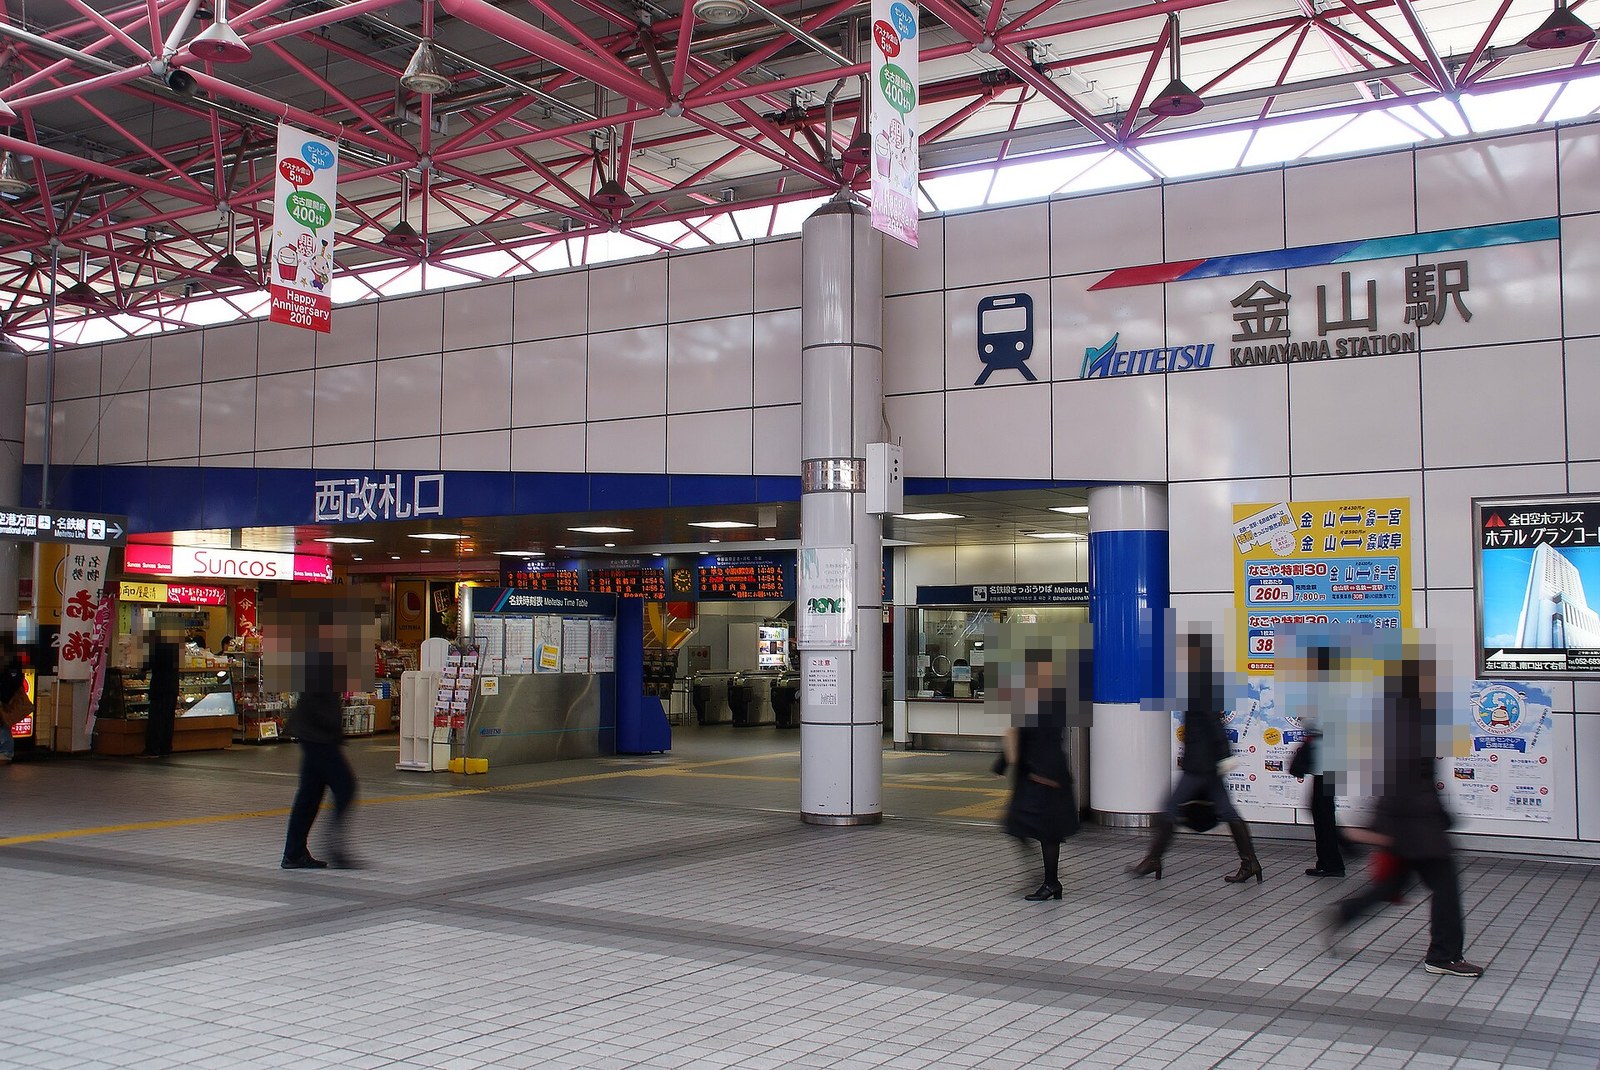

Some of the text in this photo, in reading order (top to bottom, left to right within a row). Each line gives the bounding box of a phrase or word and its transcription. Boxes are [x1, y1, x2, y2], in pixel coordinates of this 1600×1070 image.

[885, 81, 911, 111] 400th
[311, 153, 325, 166] 5th
[290, 170, 302, 183] 5th
[293, 205, 325, 226] 400th
[287, 290, 316, 307] Happy
[1230, 260, 1473, 342] 金山駅
[272, 298, 330, 321] Anniversary
[290, 312, 312, 326] 2010
[1080, 331, 1215, 379] MEITETSU
[1230, 332, 1415, 367] KANAYAMA STATION
[315, 473, 444, 522] 西改札口
[1301, 511, 1336, 528] 金山
[1508, 512, 1584, 526] 全日空ホテルズ
[54, 530, 86, 539] Meitetsu Line
[1530, 527, 1600, 545] グランコー
[1301, 535, 1336, 552] 金山
[1248, 564, 1327, 576] なごや特割30
[1330, 566, 1354, 582] 金山
[990, 584, 1052, 594] 名鉄線きっぷうりば
[1295, 593, 1326, 601] 7,800円
[508, 594, 589, 608] 名鉄時刻表 Meitetsu Time Table
